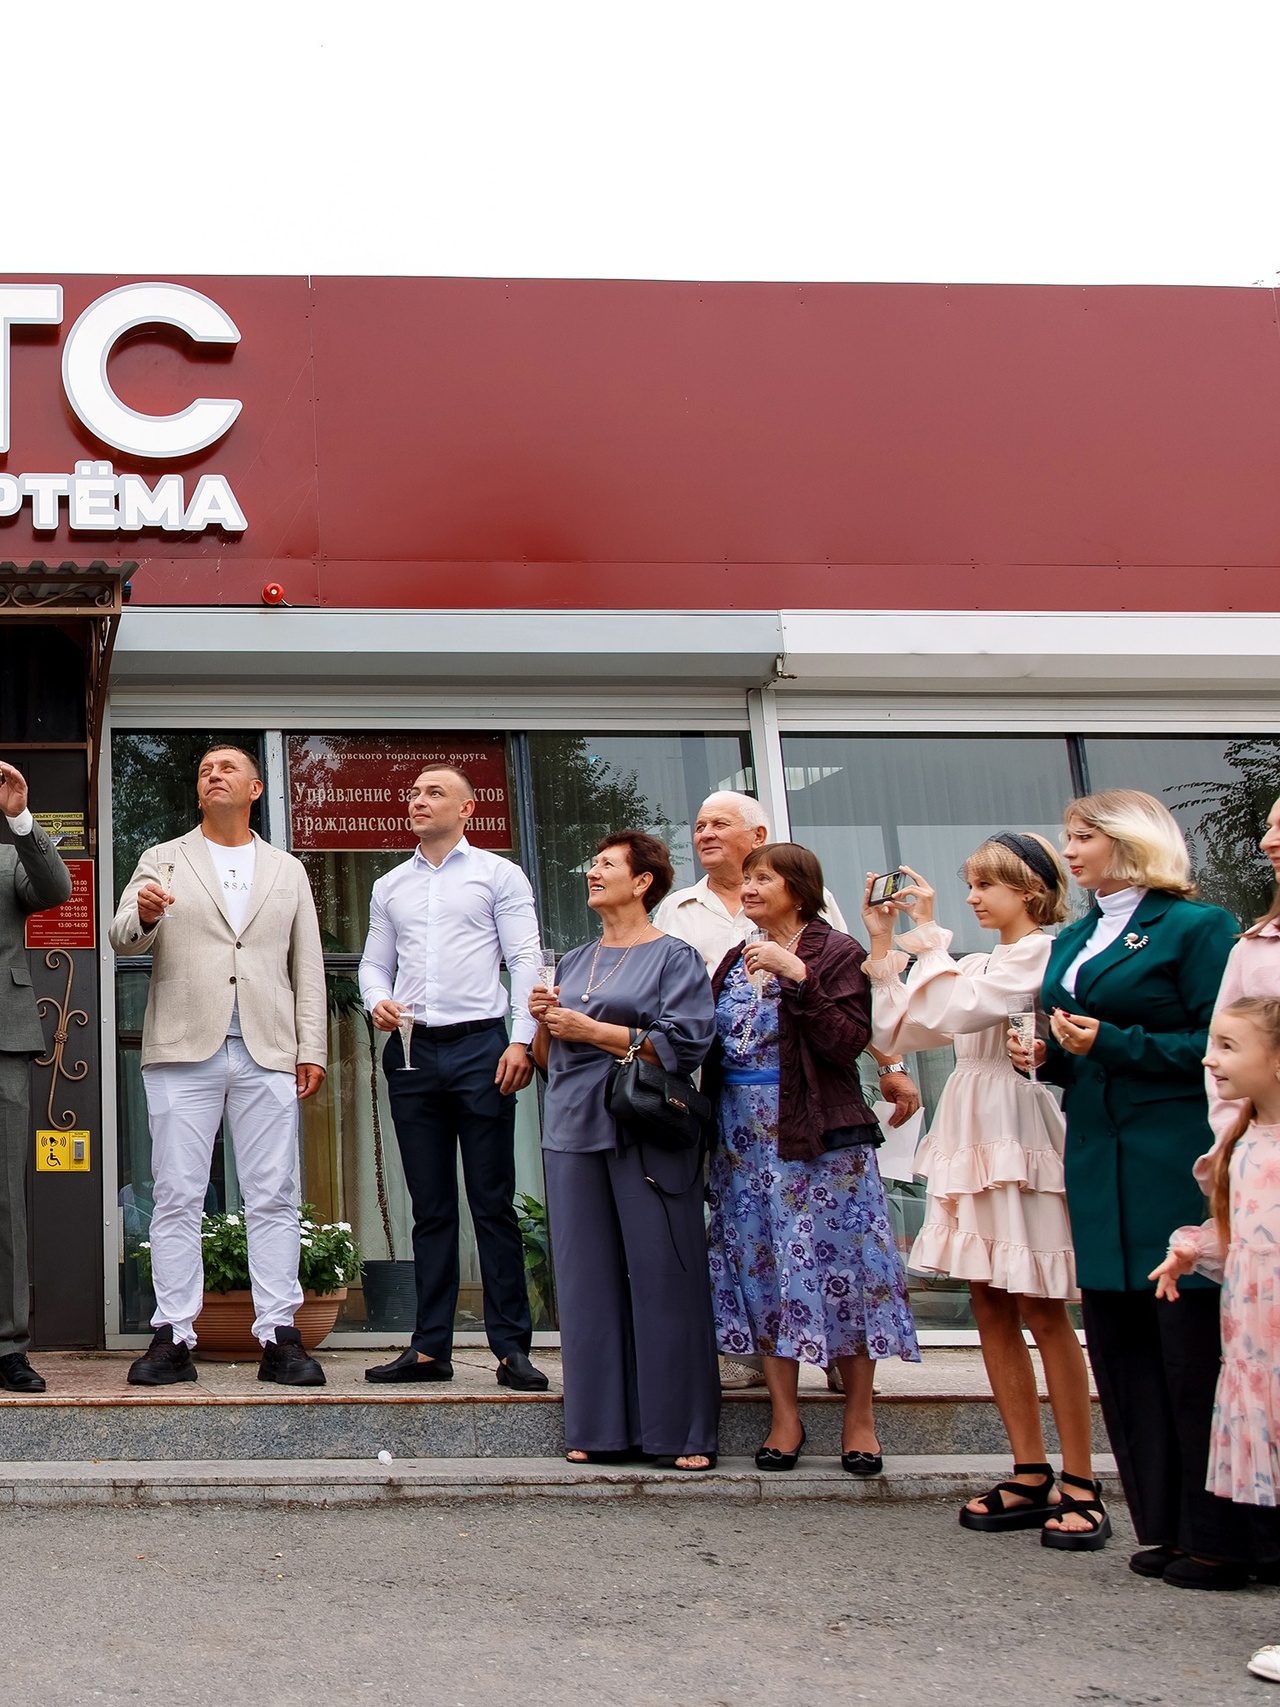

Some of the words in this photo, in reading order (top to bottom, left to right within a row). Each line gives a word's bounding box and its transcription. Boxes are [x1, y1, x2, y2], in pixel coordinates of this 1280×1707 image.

[385, 752, 446, 762] городского
[294, 782, 392, 807] Управление
[473, 788, 505, 802] ктов
[295, 816, 413, 836] гражданского
